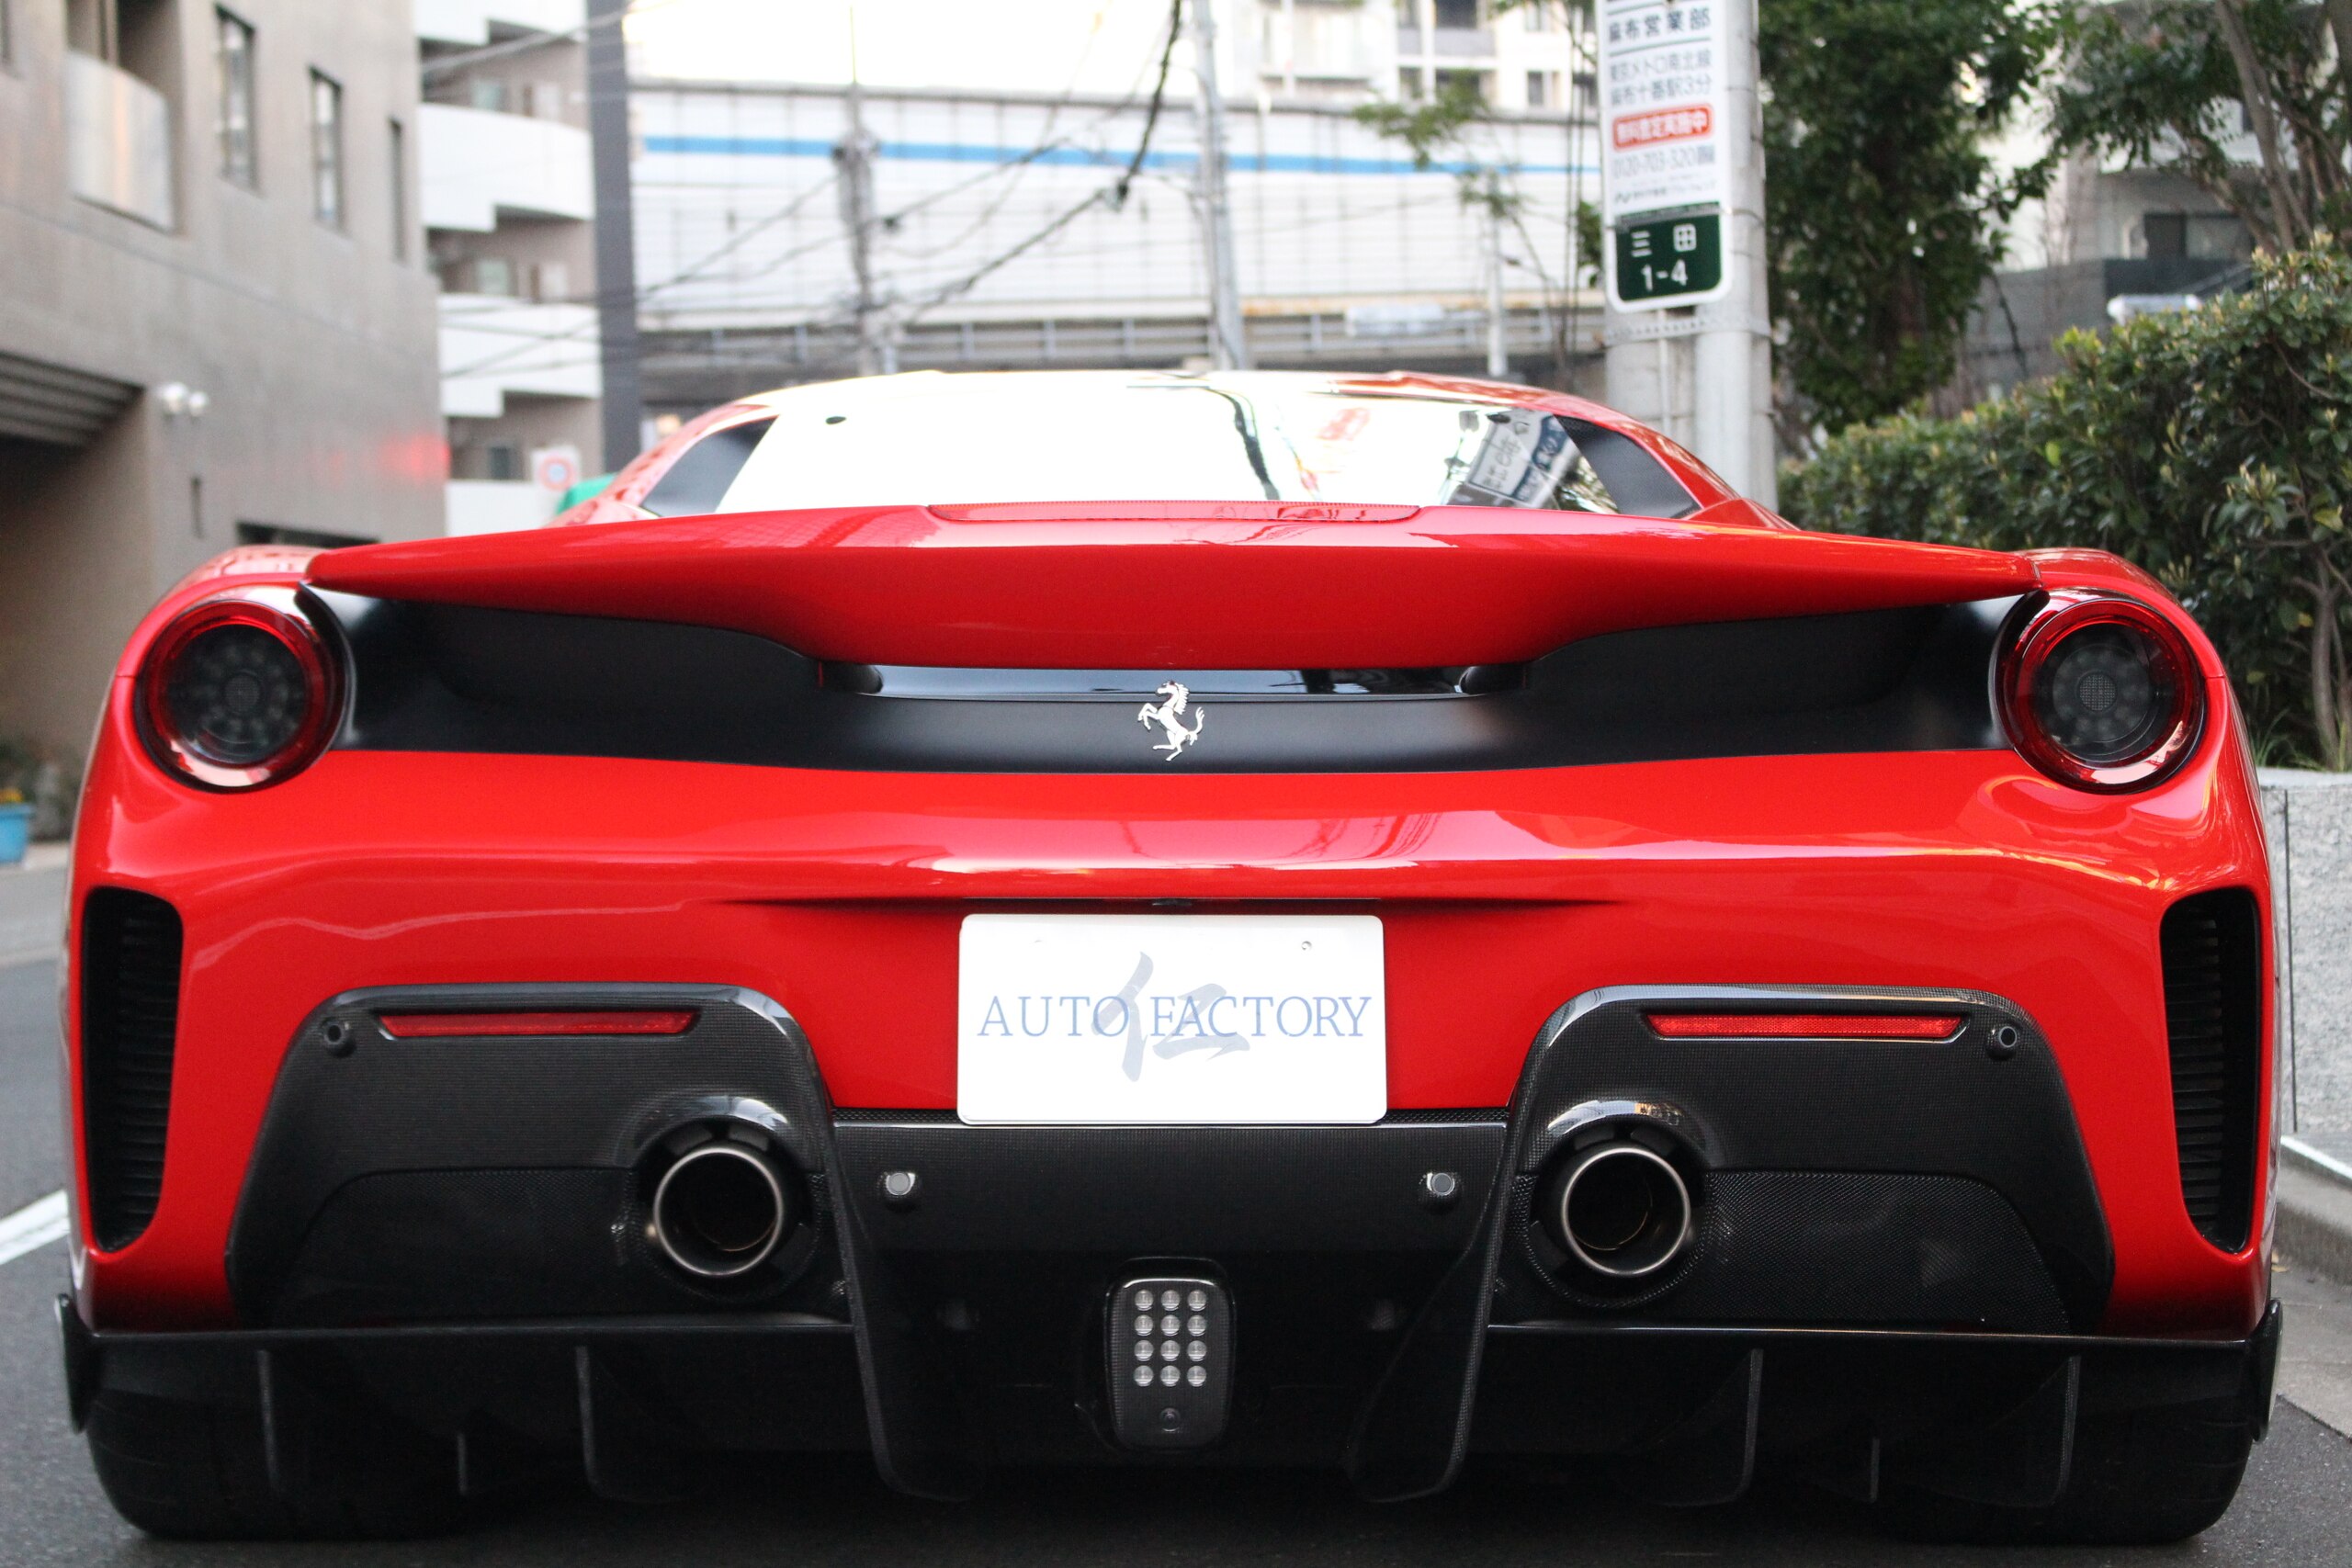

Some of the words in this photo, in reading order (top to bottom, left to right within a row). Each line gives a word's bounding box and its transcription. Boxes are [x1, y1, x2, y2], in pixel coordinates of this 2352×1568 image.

[1609, 7, 1711, 43] 麻布営業部
[1631, 223, 1697, 257] 三田
[1641, 259, 1689, 292] 1-4
[977, 995, 1130, 1037] AUTO
[1149, 995, 1372, 1037] FACTORY
